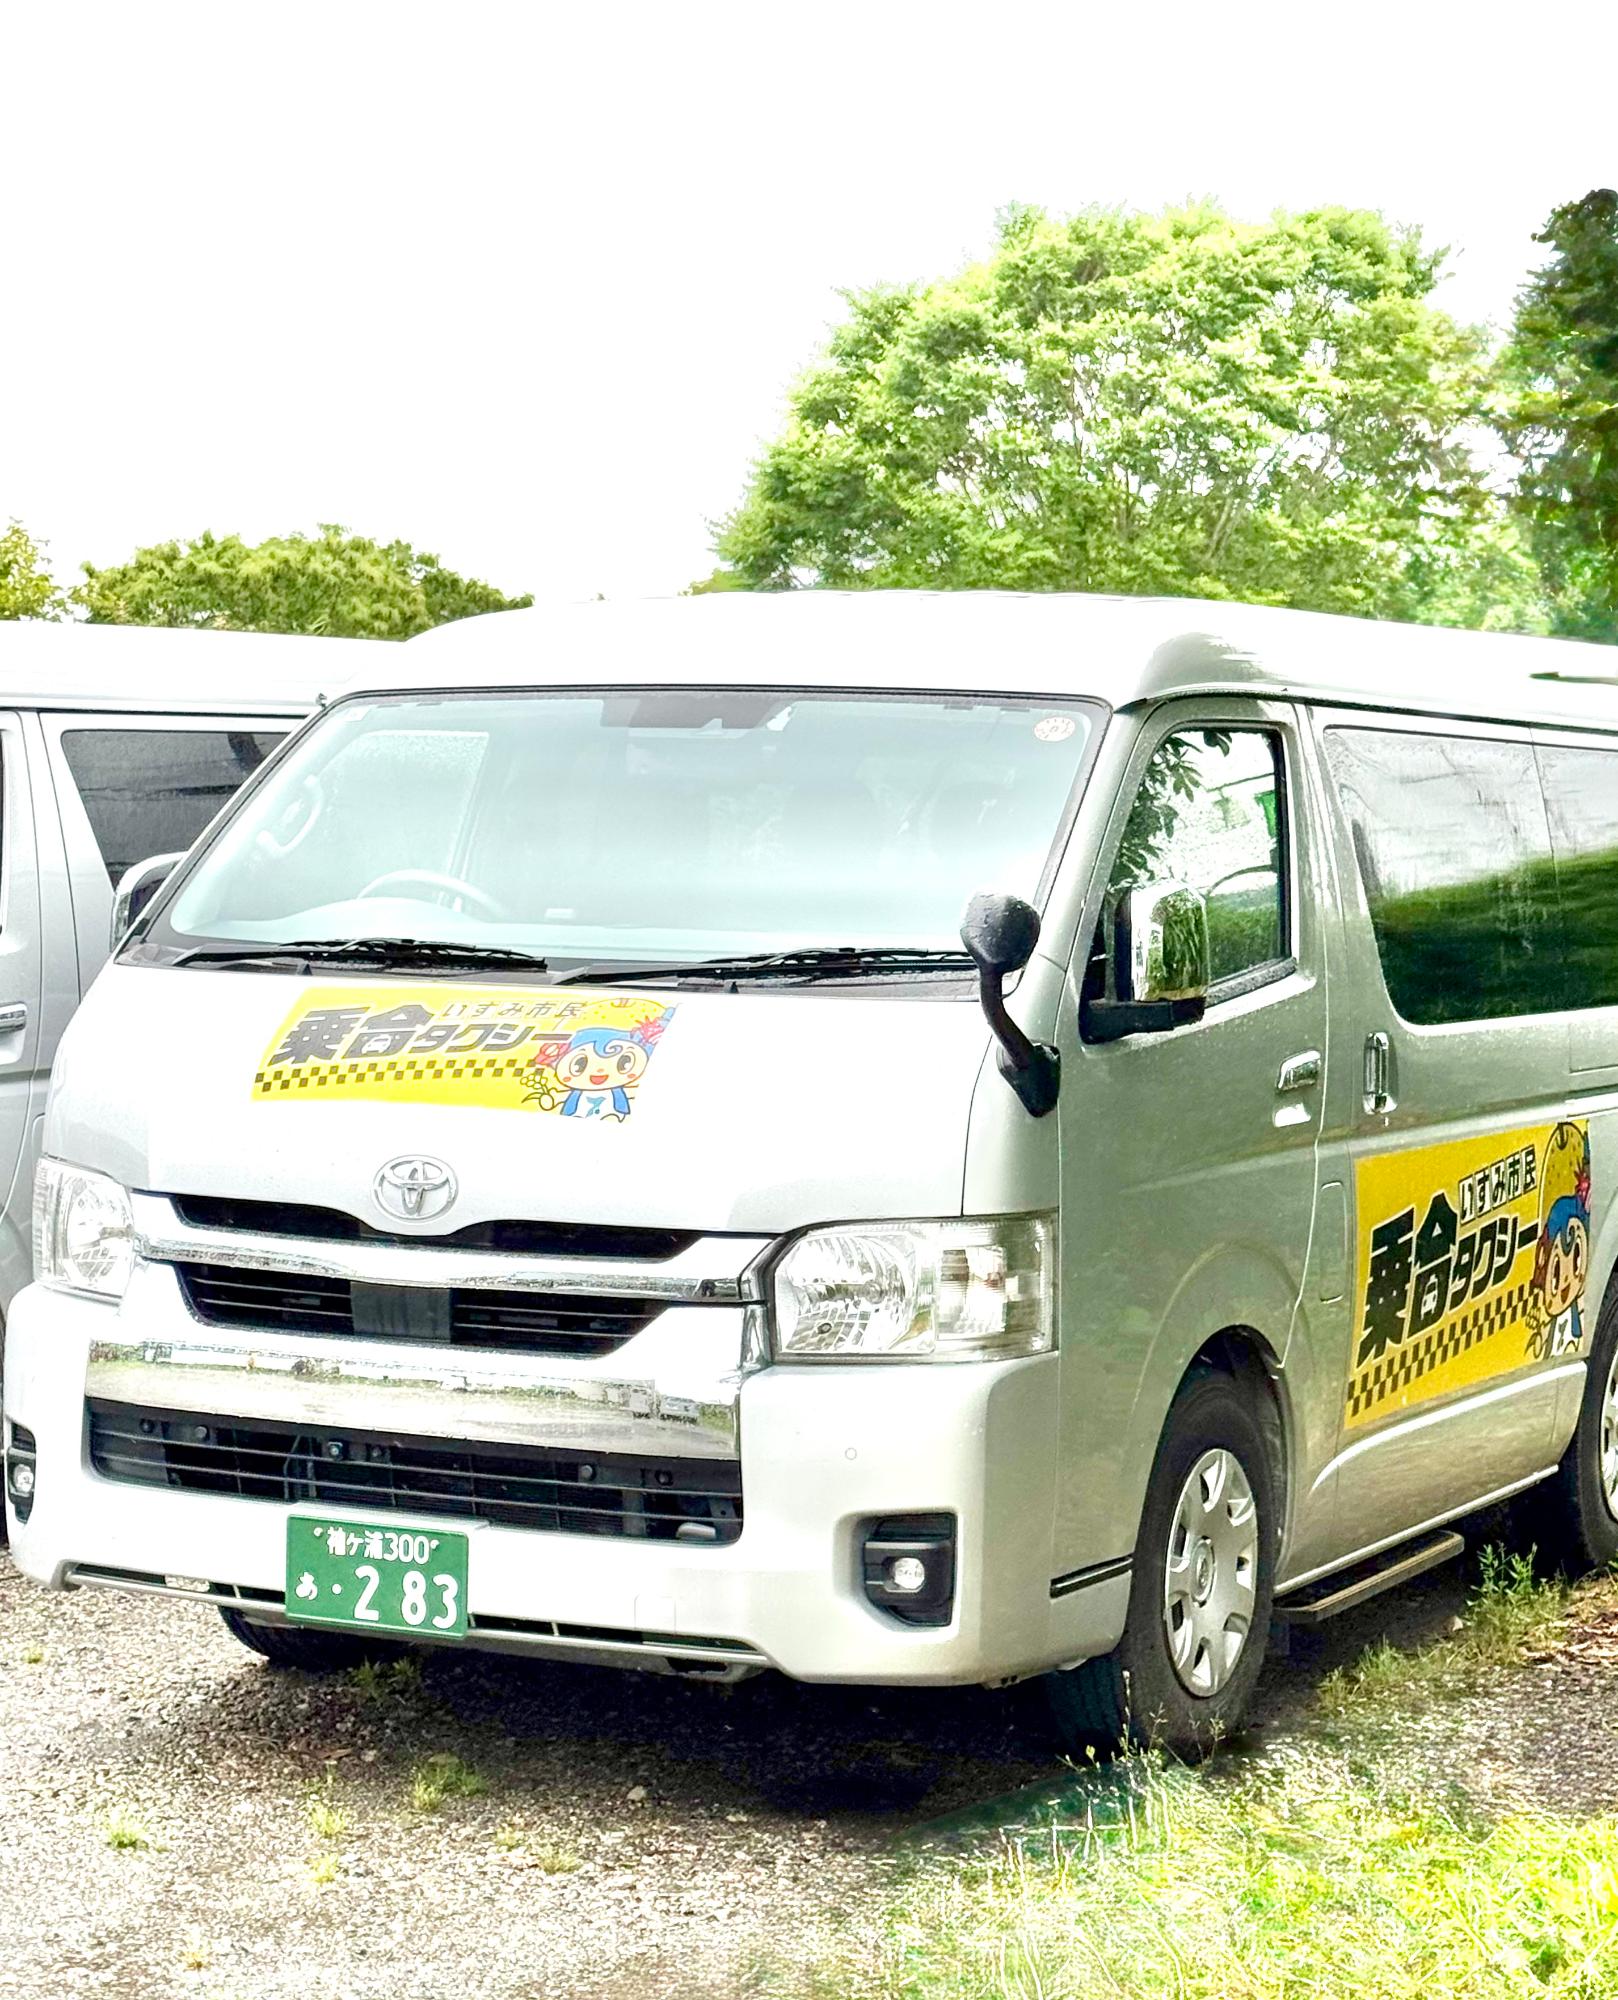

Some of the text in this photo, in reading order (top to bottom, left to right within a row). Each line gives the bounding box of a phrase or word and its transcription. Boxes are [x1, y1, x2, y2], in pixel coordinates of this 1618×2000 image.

[443, 1001, 587, 1018] いすみ市民
[1461, 1146, 1536, 1221] いすみ市民
